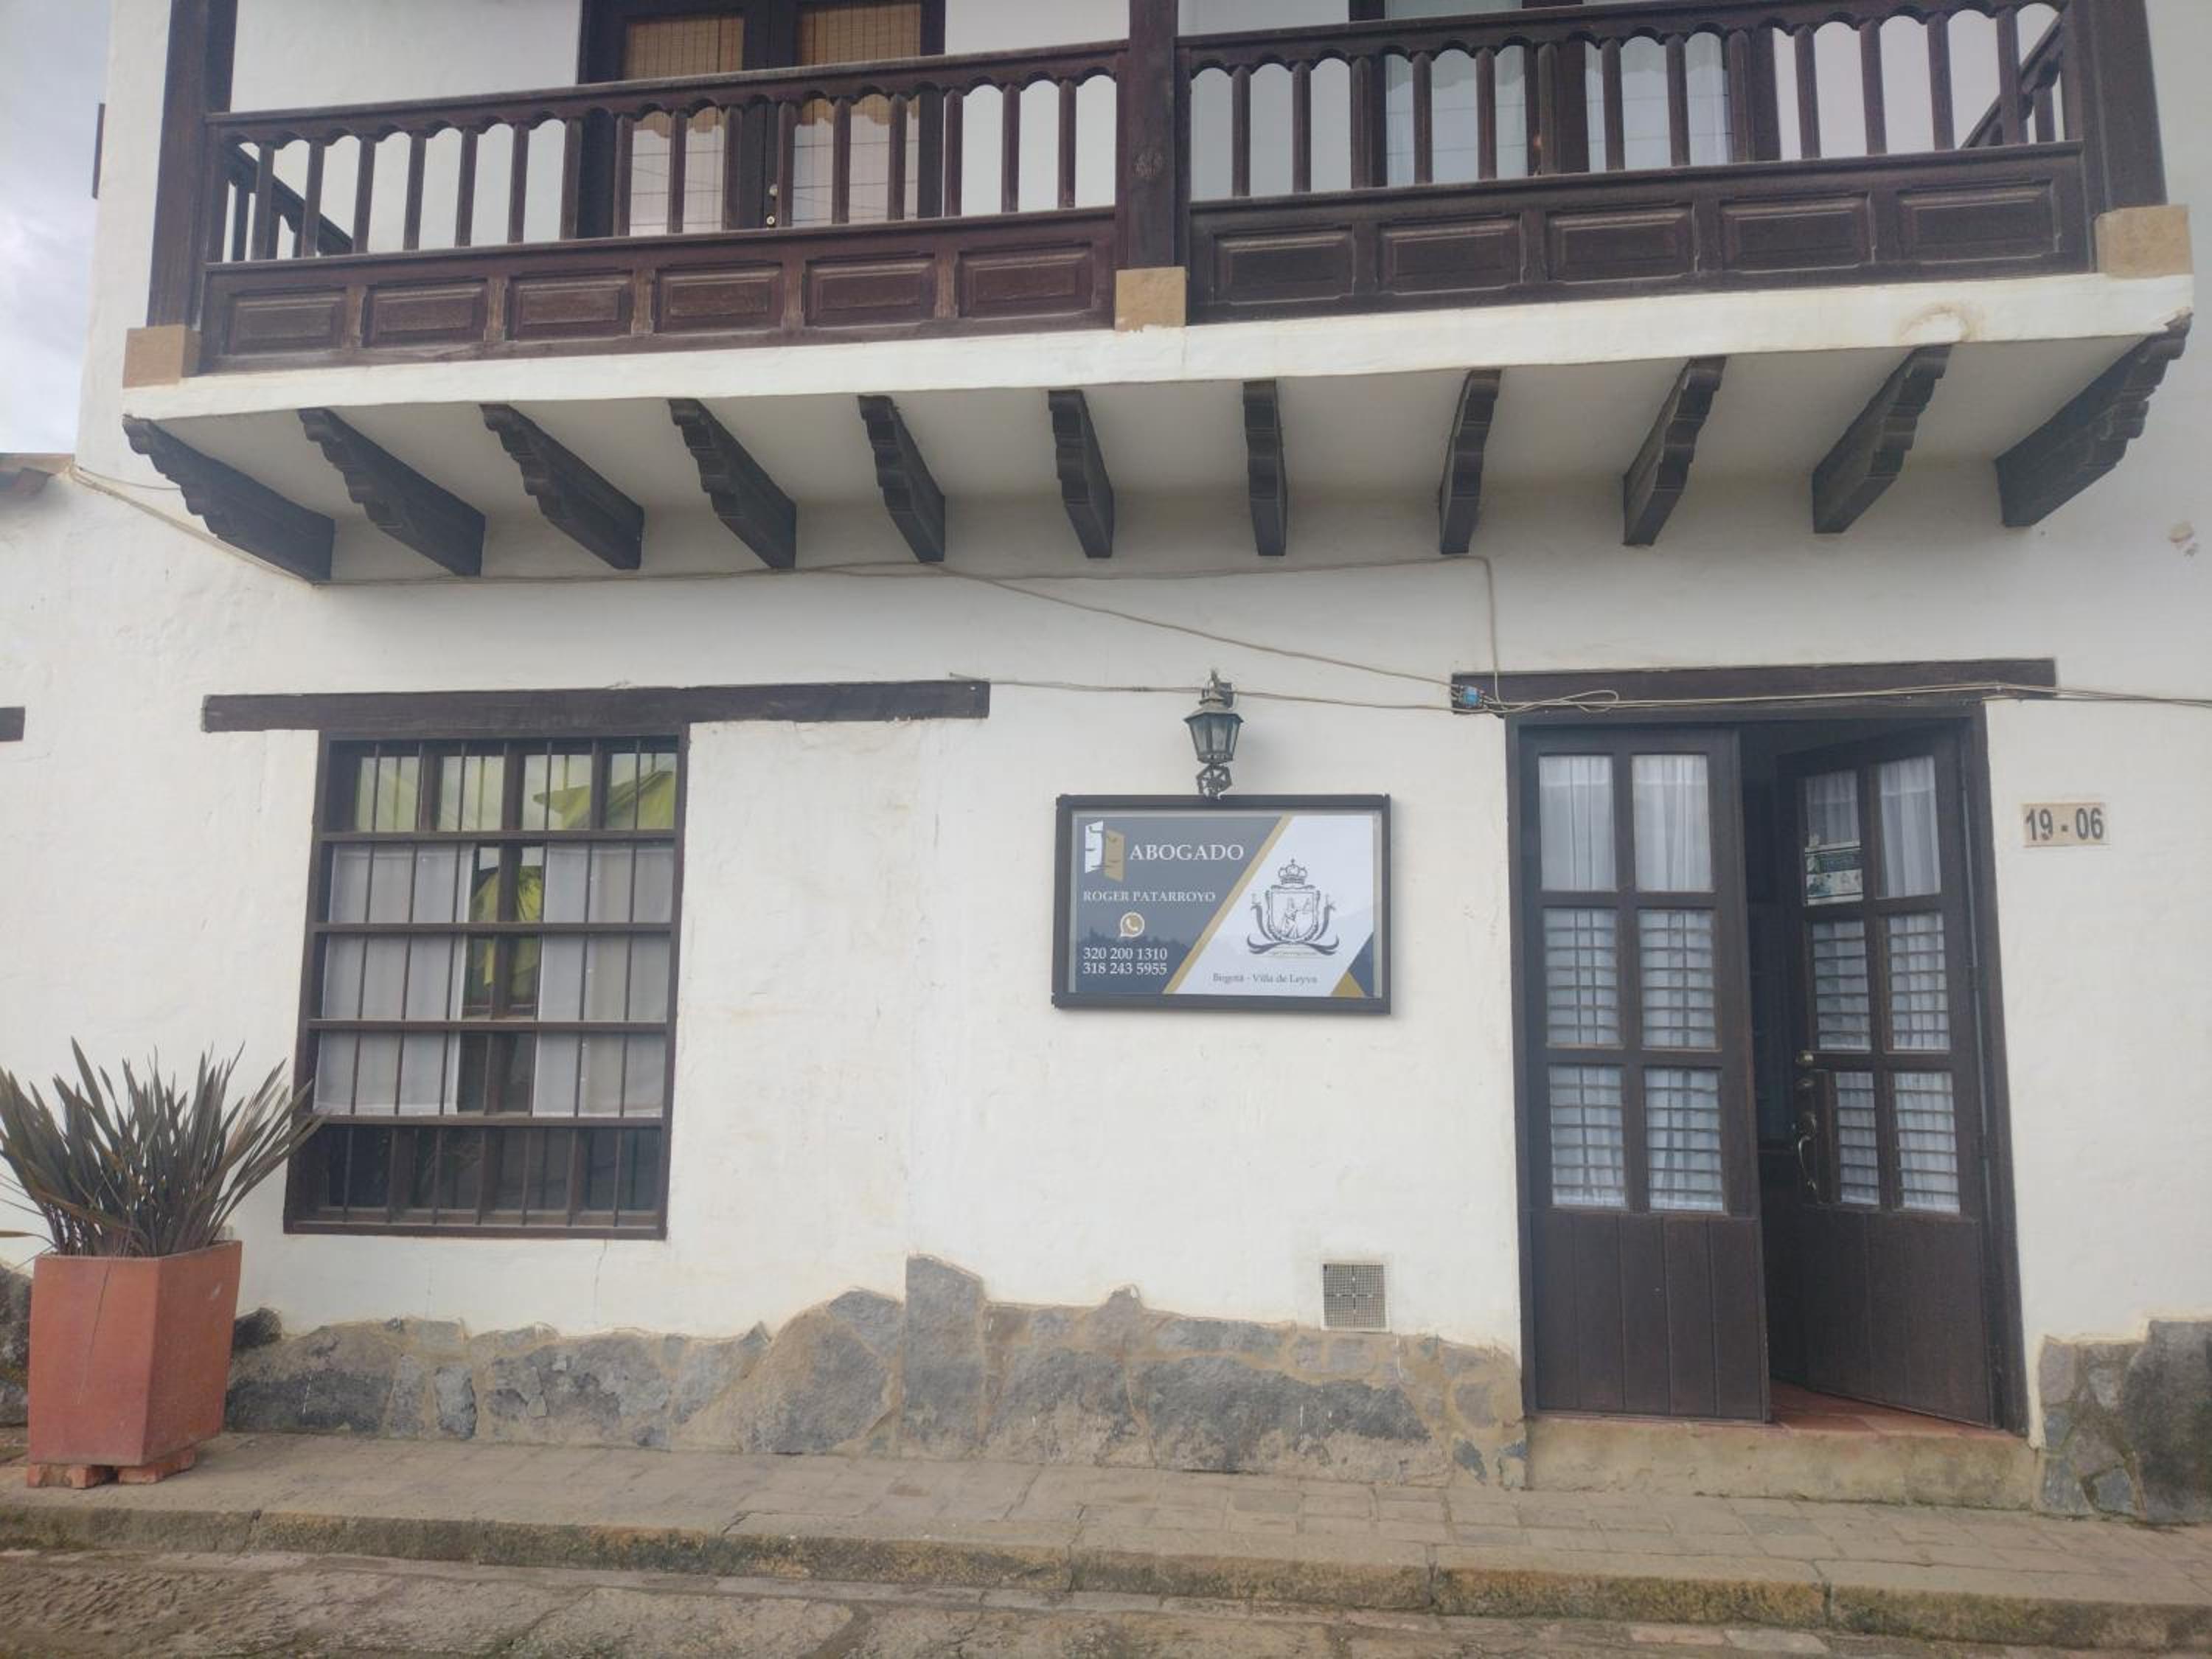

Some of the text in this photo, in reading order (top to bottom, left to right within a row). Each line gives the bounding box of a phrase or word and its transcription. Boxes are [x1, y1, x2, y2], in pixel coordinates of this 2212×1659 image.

[1130, 844, 1244, 860] ABOGADO
[1084, 891, 1215, 902] ROGER PATARROYO
[1084, 947, 1167, 960] 320 200 1310
[1084, 962, 1167, 975] 318 243 5955
[1276, 974, 1287, 982] de
